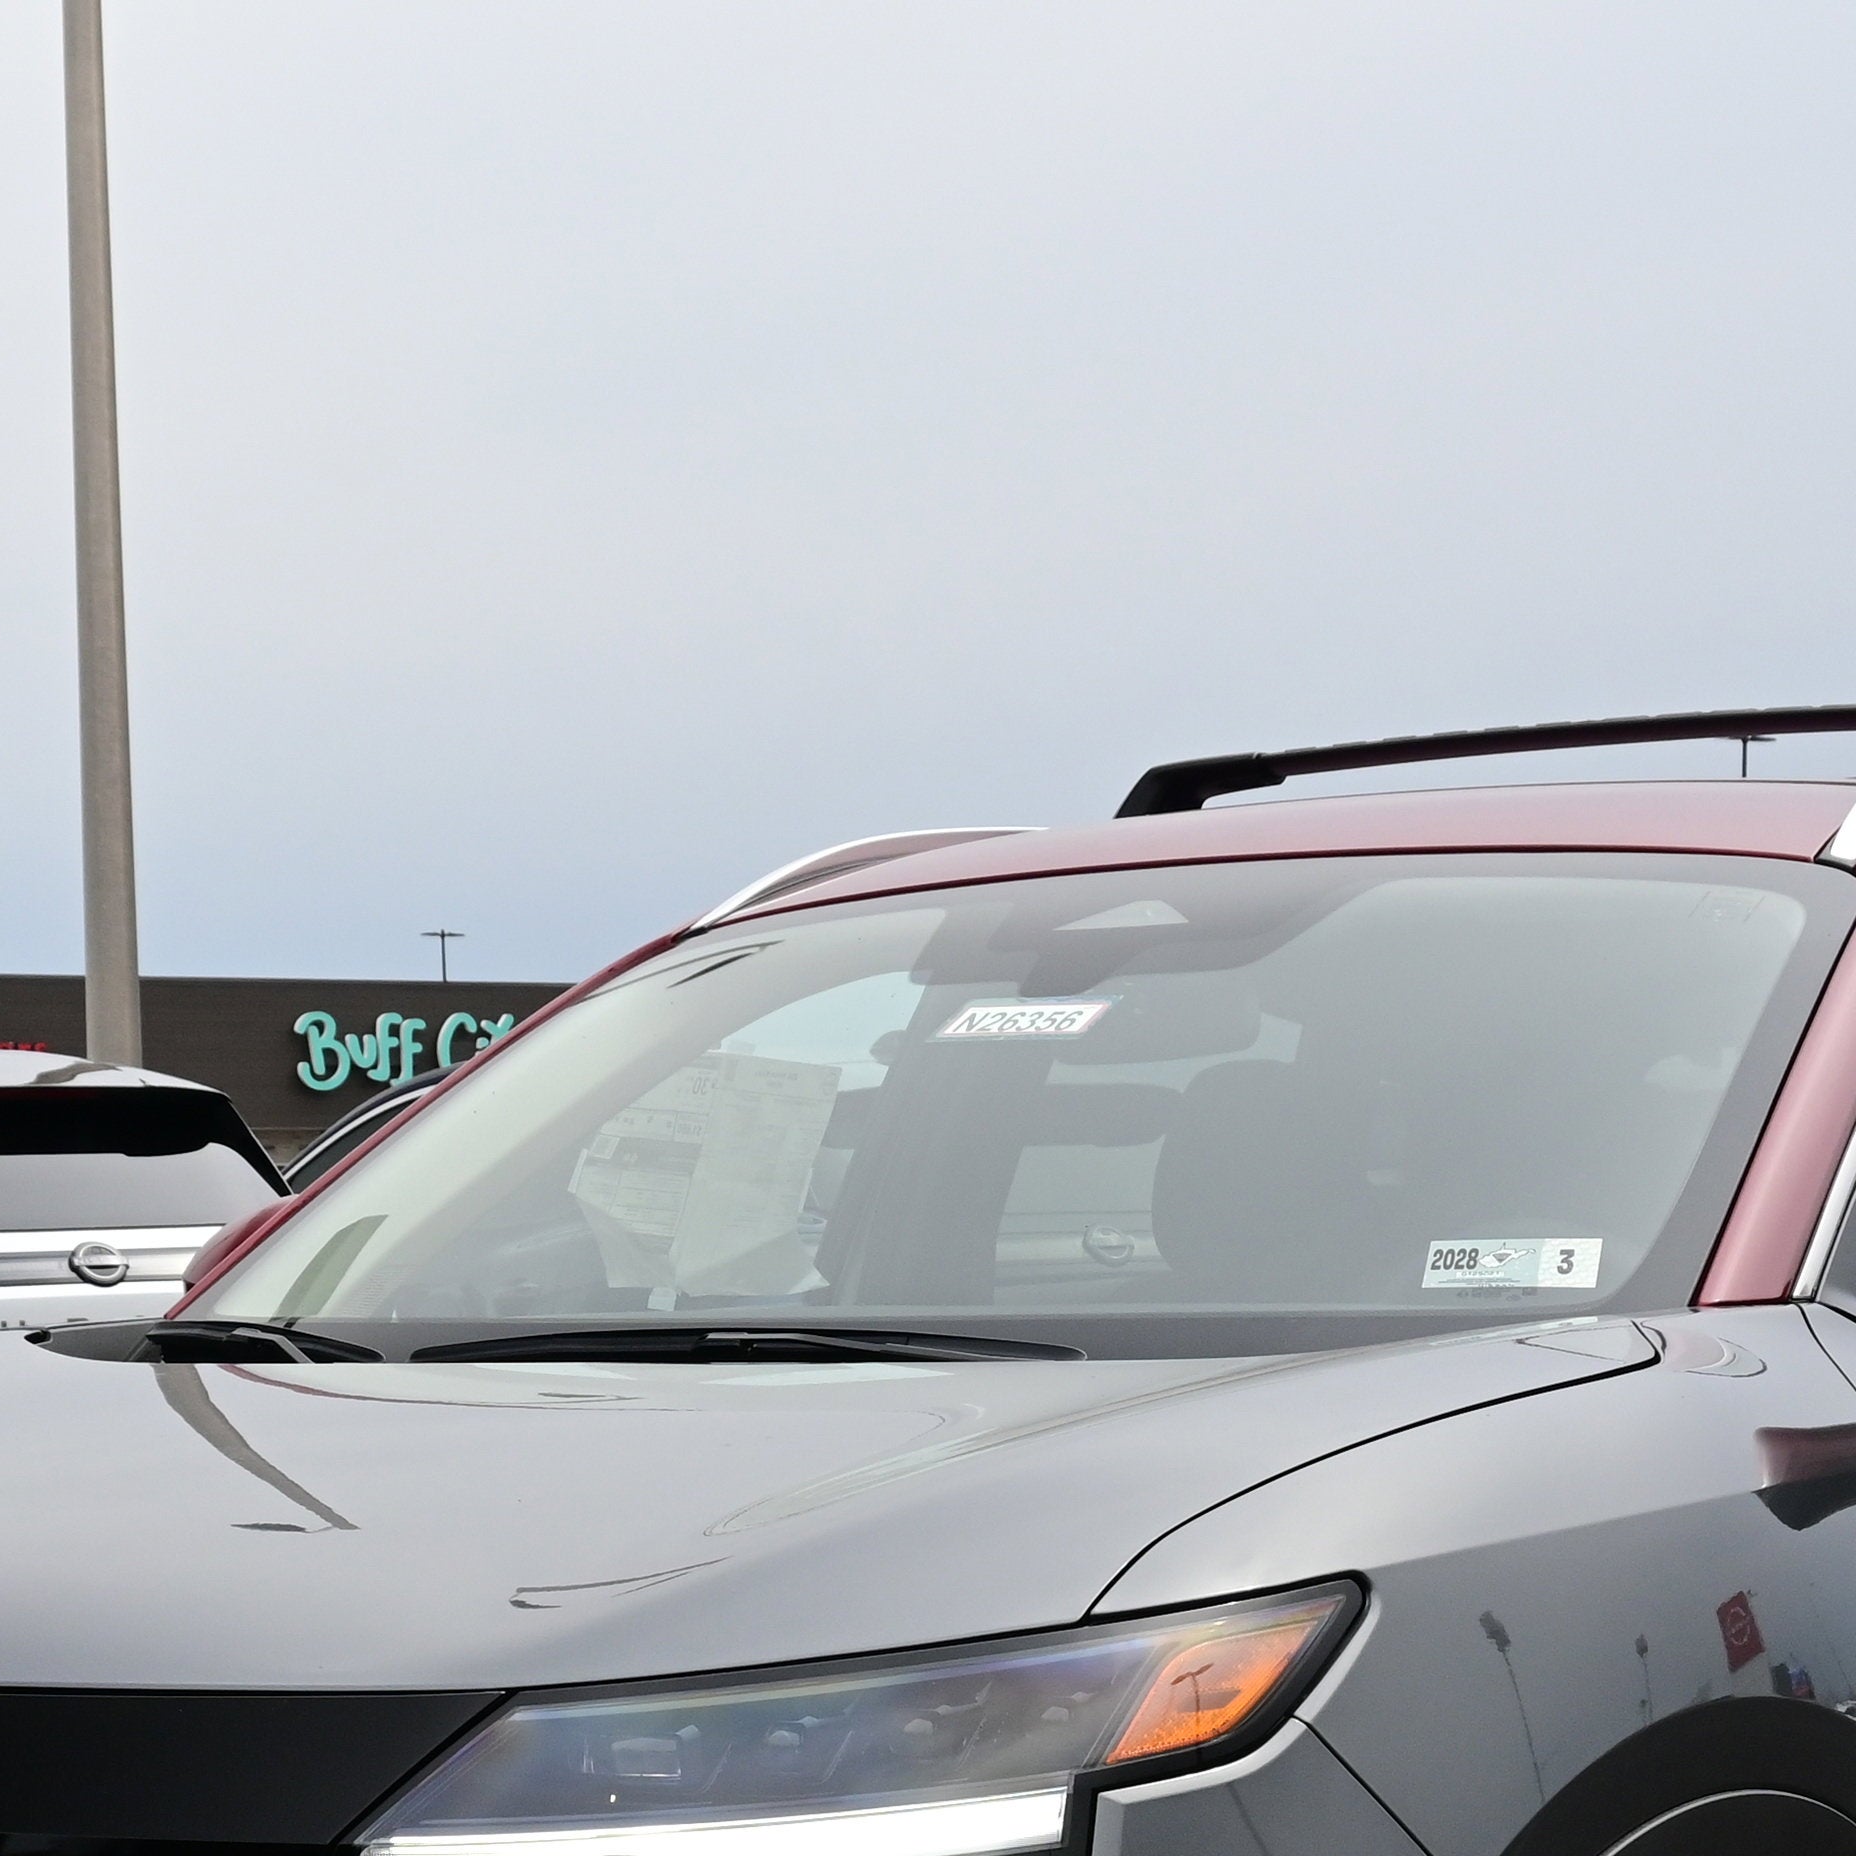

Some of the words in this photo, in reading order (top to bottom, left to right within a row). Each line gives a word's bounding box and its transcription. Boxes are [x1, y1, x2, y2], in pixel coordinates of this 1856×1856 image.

[952, 1010, 1084, 1033] N26356
[294, 1011, 427, 1092] Buff
[1430, 1247, 1480, 1271] 2028
[1557, 1249, 1575, 1275] 3
